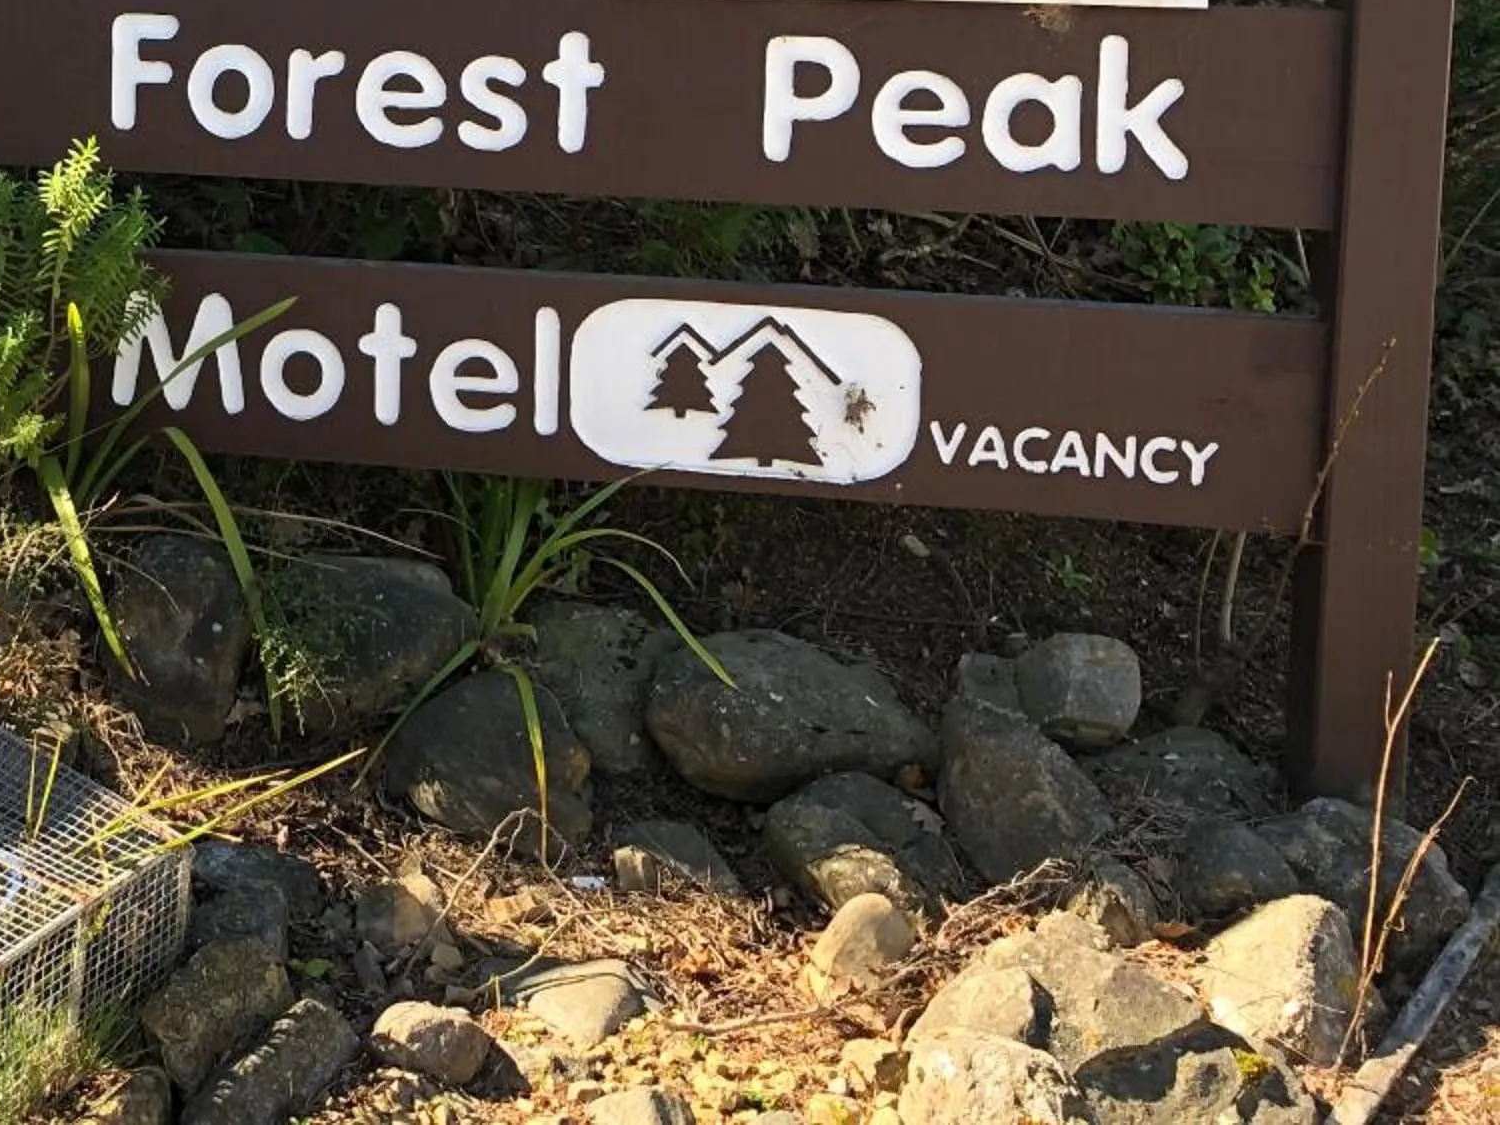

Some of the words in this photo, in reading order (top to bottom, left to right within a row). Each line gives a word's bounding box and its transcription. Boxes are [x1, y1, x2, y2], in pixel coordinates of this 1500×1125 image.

[110, 12, 605, 153] Forest
[762, 34, 1188, 180] Peak
[111, 291, 560, 436] Motel
[929, 420, 1221, 487] VACANCY
